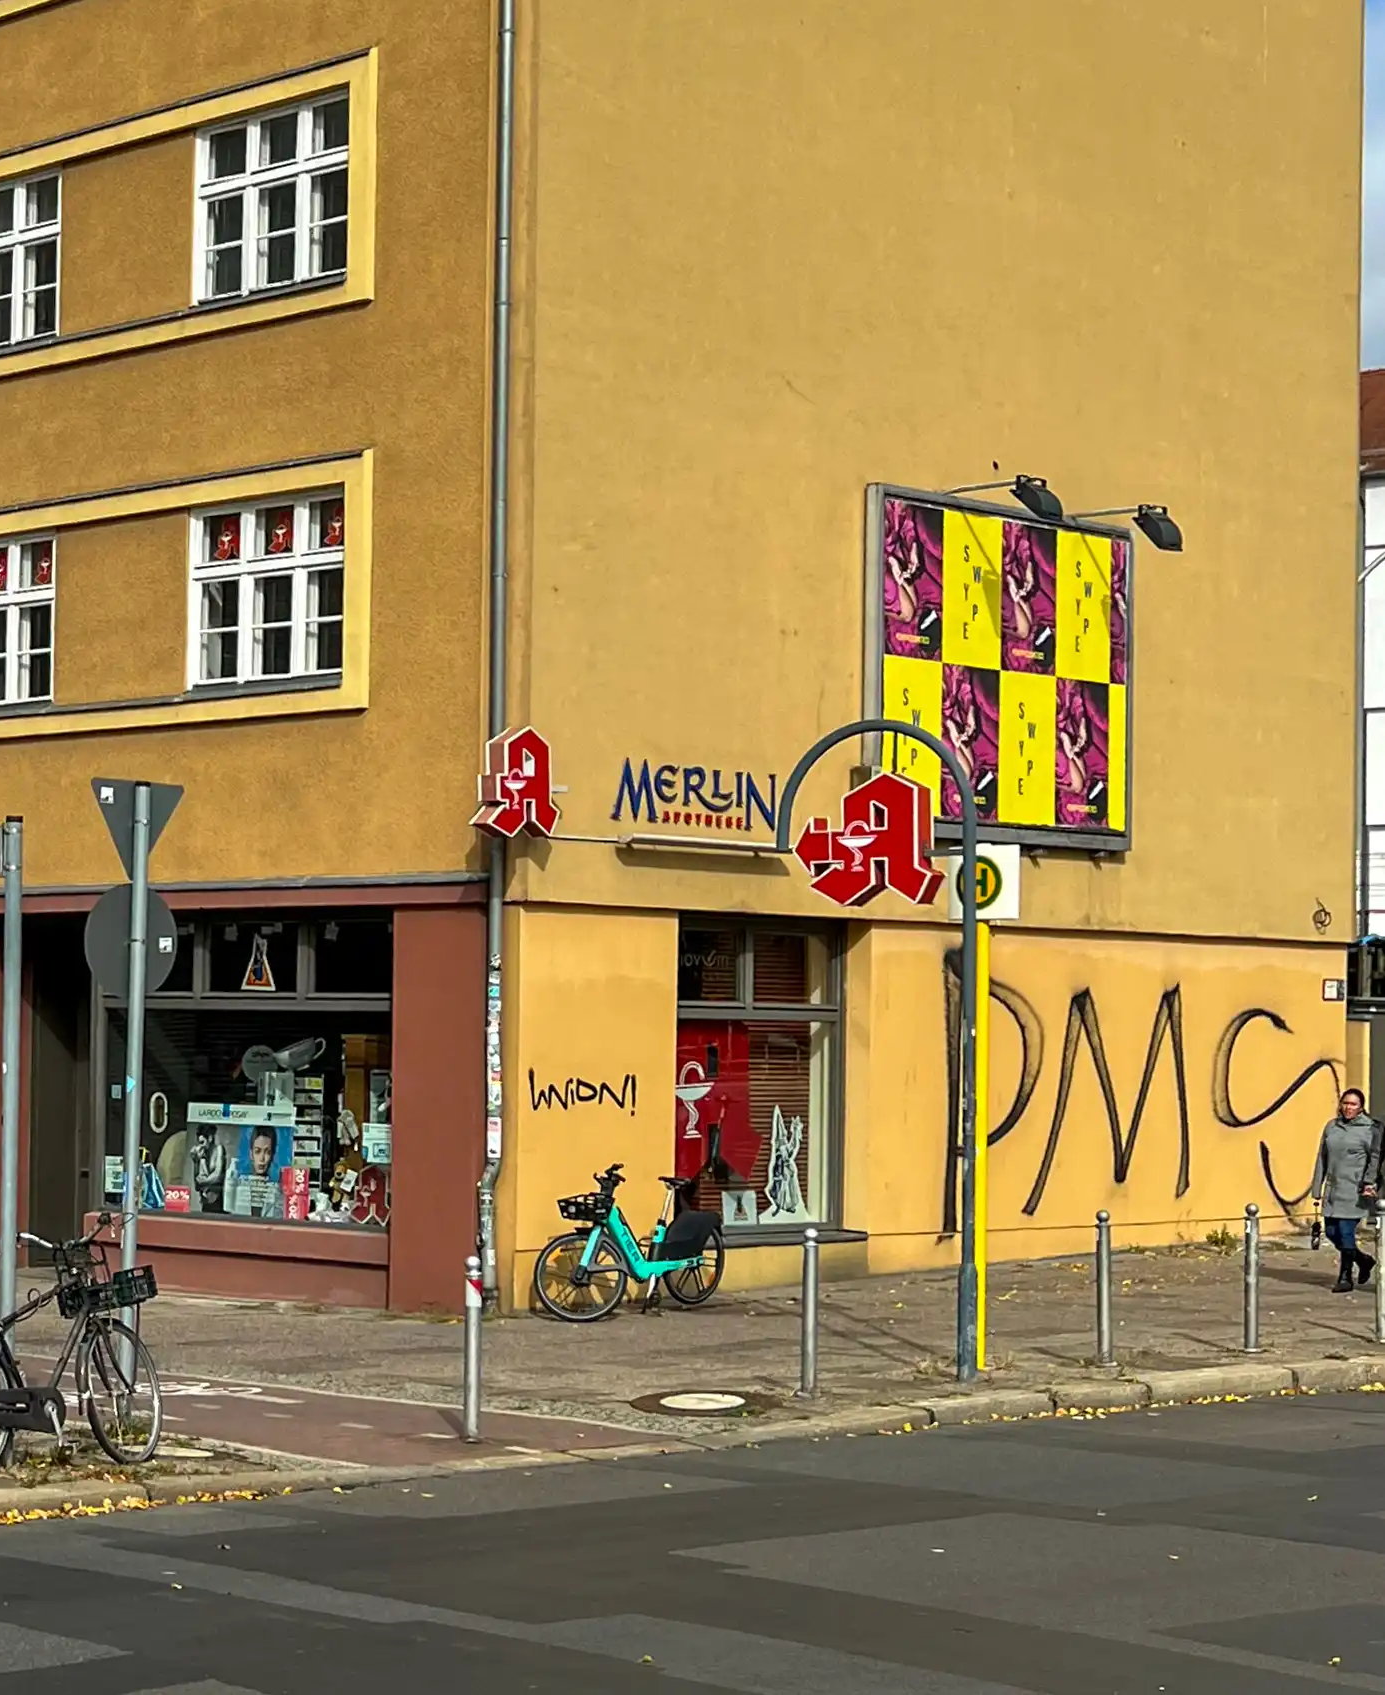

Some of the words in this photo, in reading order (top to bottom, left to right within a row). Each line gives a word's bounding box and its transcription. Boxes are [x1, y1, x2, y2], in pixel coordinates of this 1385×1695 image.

[963, 545, 982, 640] SWYPE
[1075, 561, 1093, 654] SWYPE
[610, 757, 777, 833] MERLIN
[1017, 702, 1037, 796] SWYPE
[165, 1190, 190, 1201] 20%
